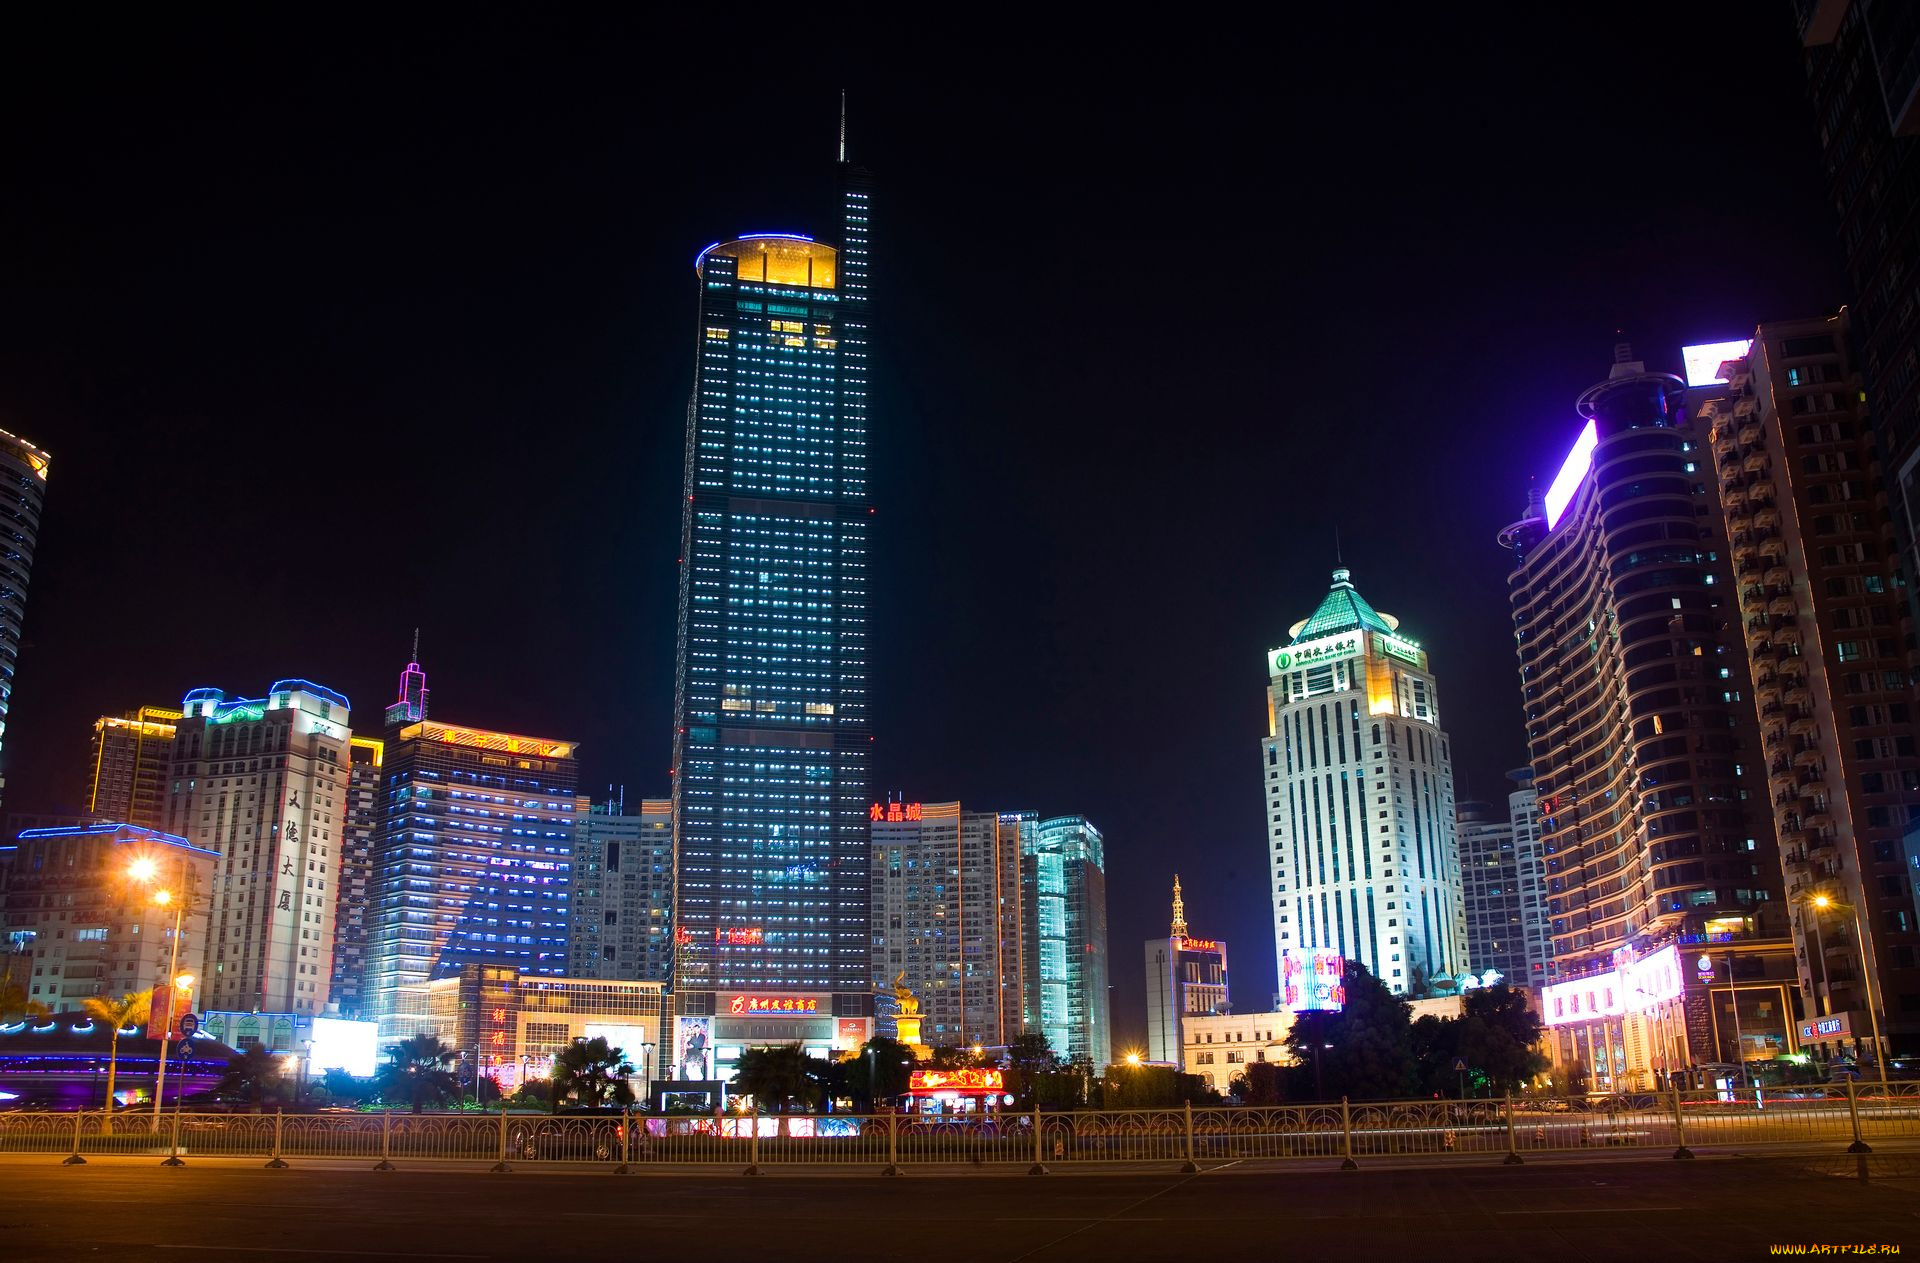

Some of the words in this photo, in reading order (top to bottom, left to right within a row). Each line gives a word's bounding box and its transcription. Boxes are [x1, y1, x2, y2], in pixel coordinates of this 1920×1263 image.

[1294, 638, 1356, 662] 中国农业银行
[870, 803, 922, 822] 水晶城
